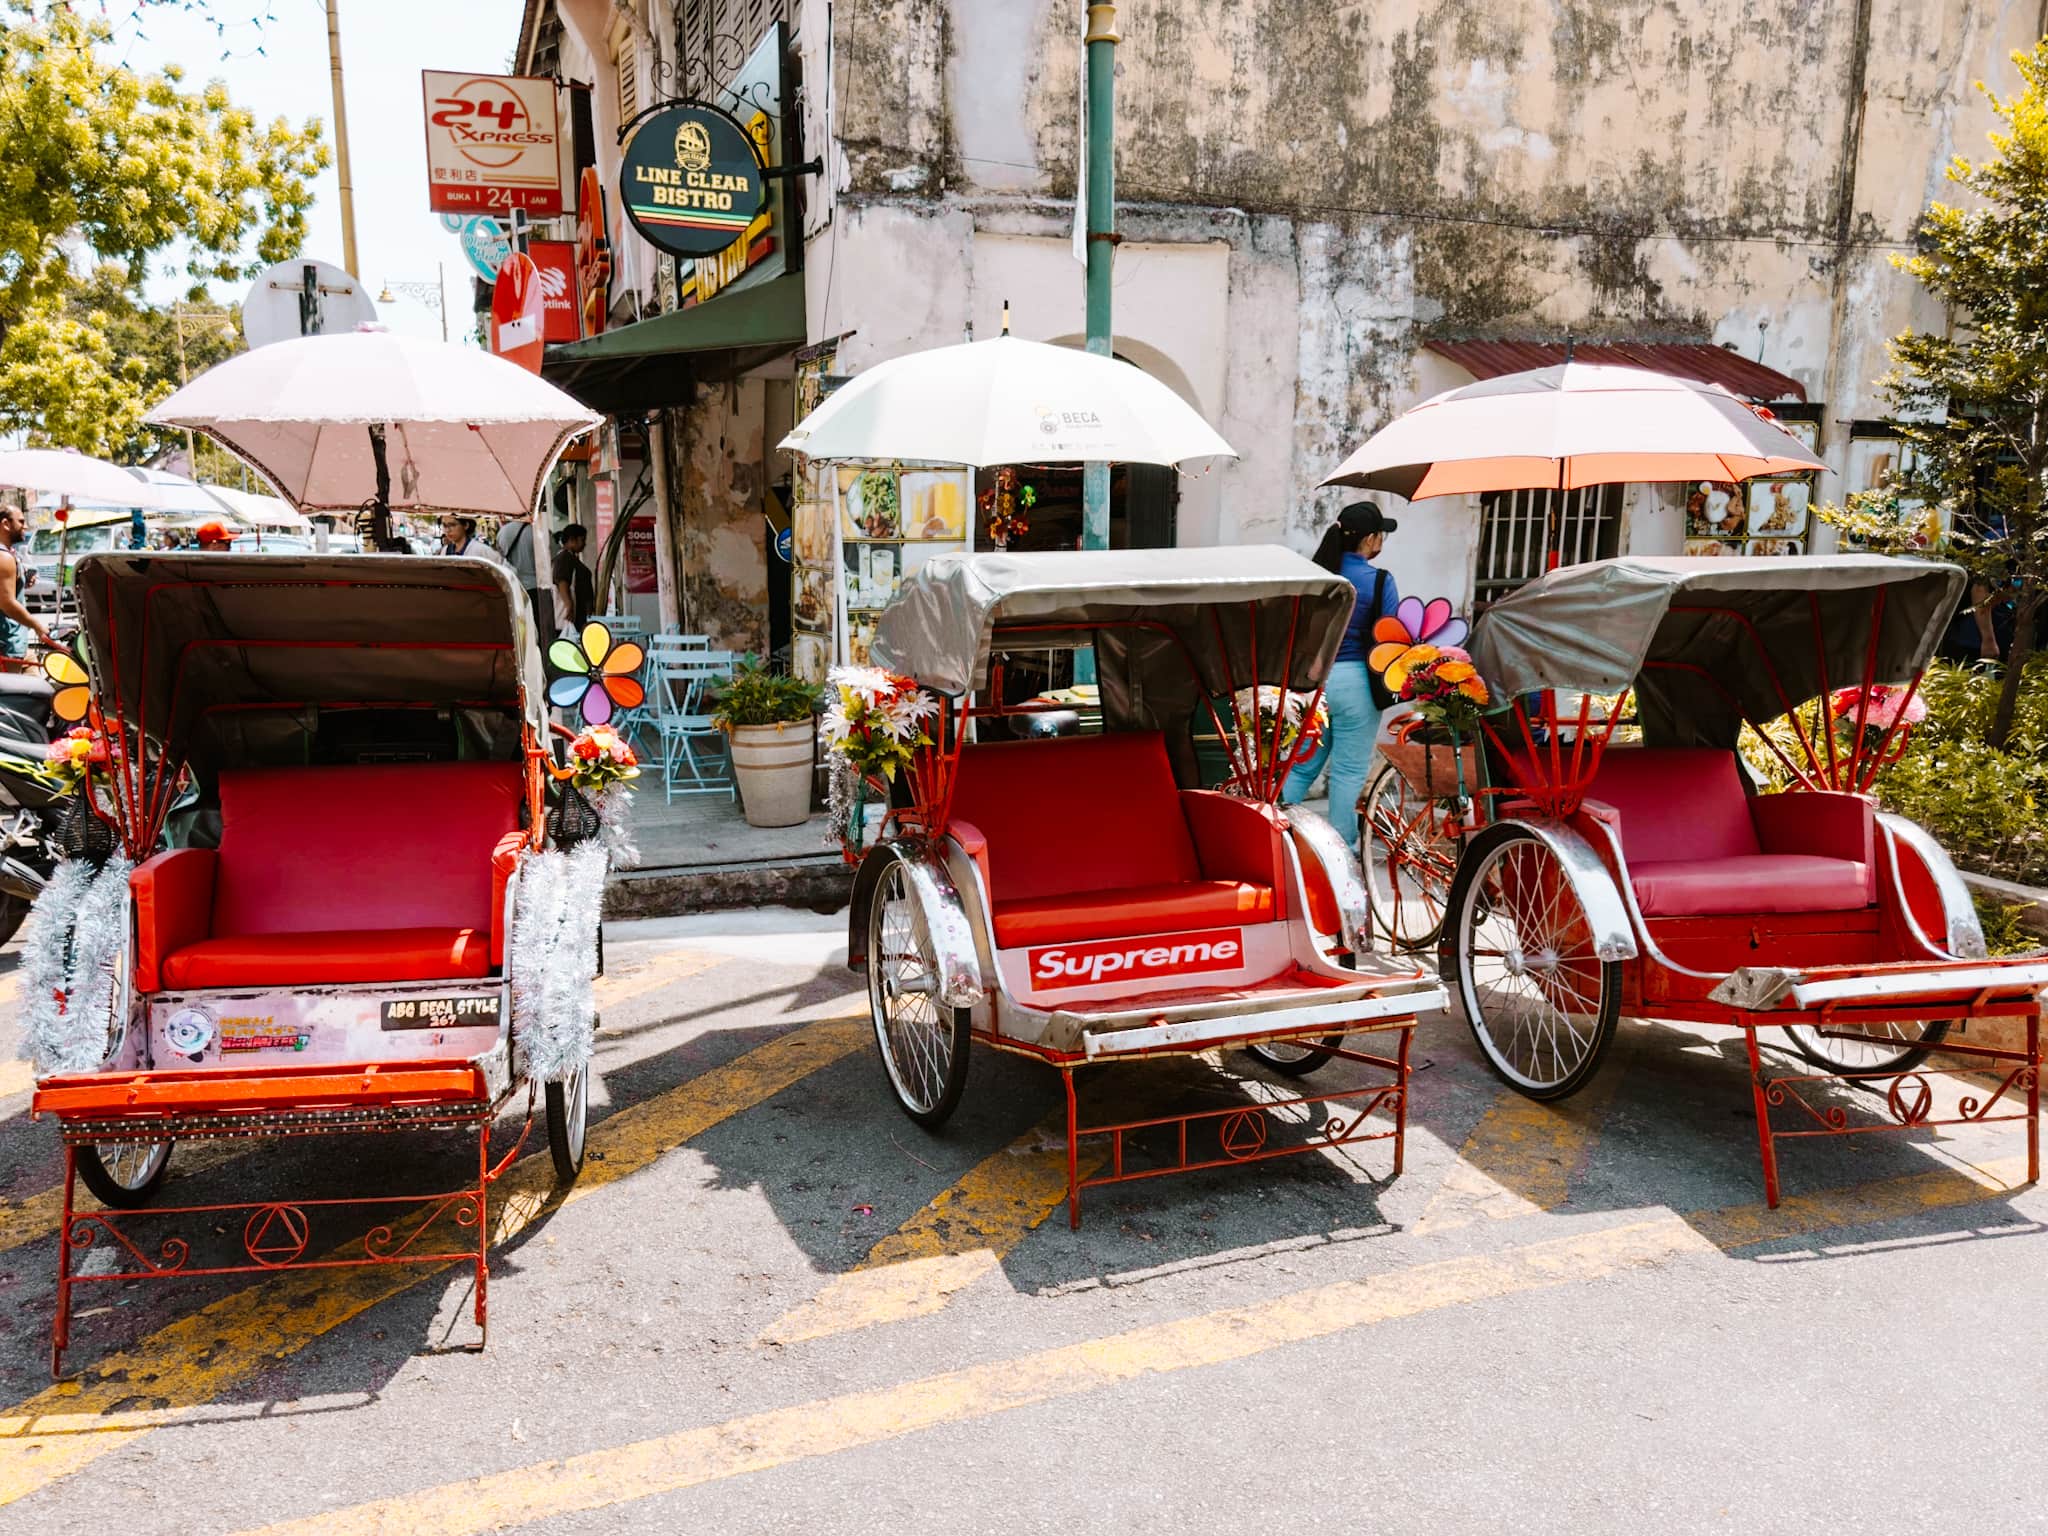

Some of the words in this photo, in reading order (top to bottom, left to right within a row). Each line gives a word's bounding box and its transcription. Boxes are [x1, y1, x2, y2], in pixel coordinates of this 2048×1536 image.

[431, 98, 526, 130] 24
[636, 166, 682, 185] LINE
[687, 171, 749, 192] CLEAR
[447, 192, 471, 201] BUKA
[487, 188, 514, 207] 24
[530, 197, 547, 205] JAM
[653, 185, 733, 210] BISTRO
[542, 299, 572, 310] otlink
[1062, 411, 1101, 424] BECA
[1036, 940, 1239, 981] Supreme
[419, 1000, 454, 1017] BECA
[456, 998, 499, 1015] STYLE
[429, 1014, 457, 1027] 267
